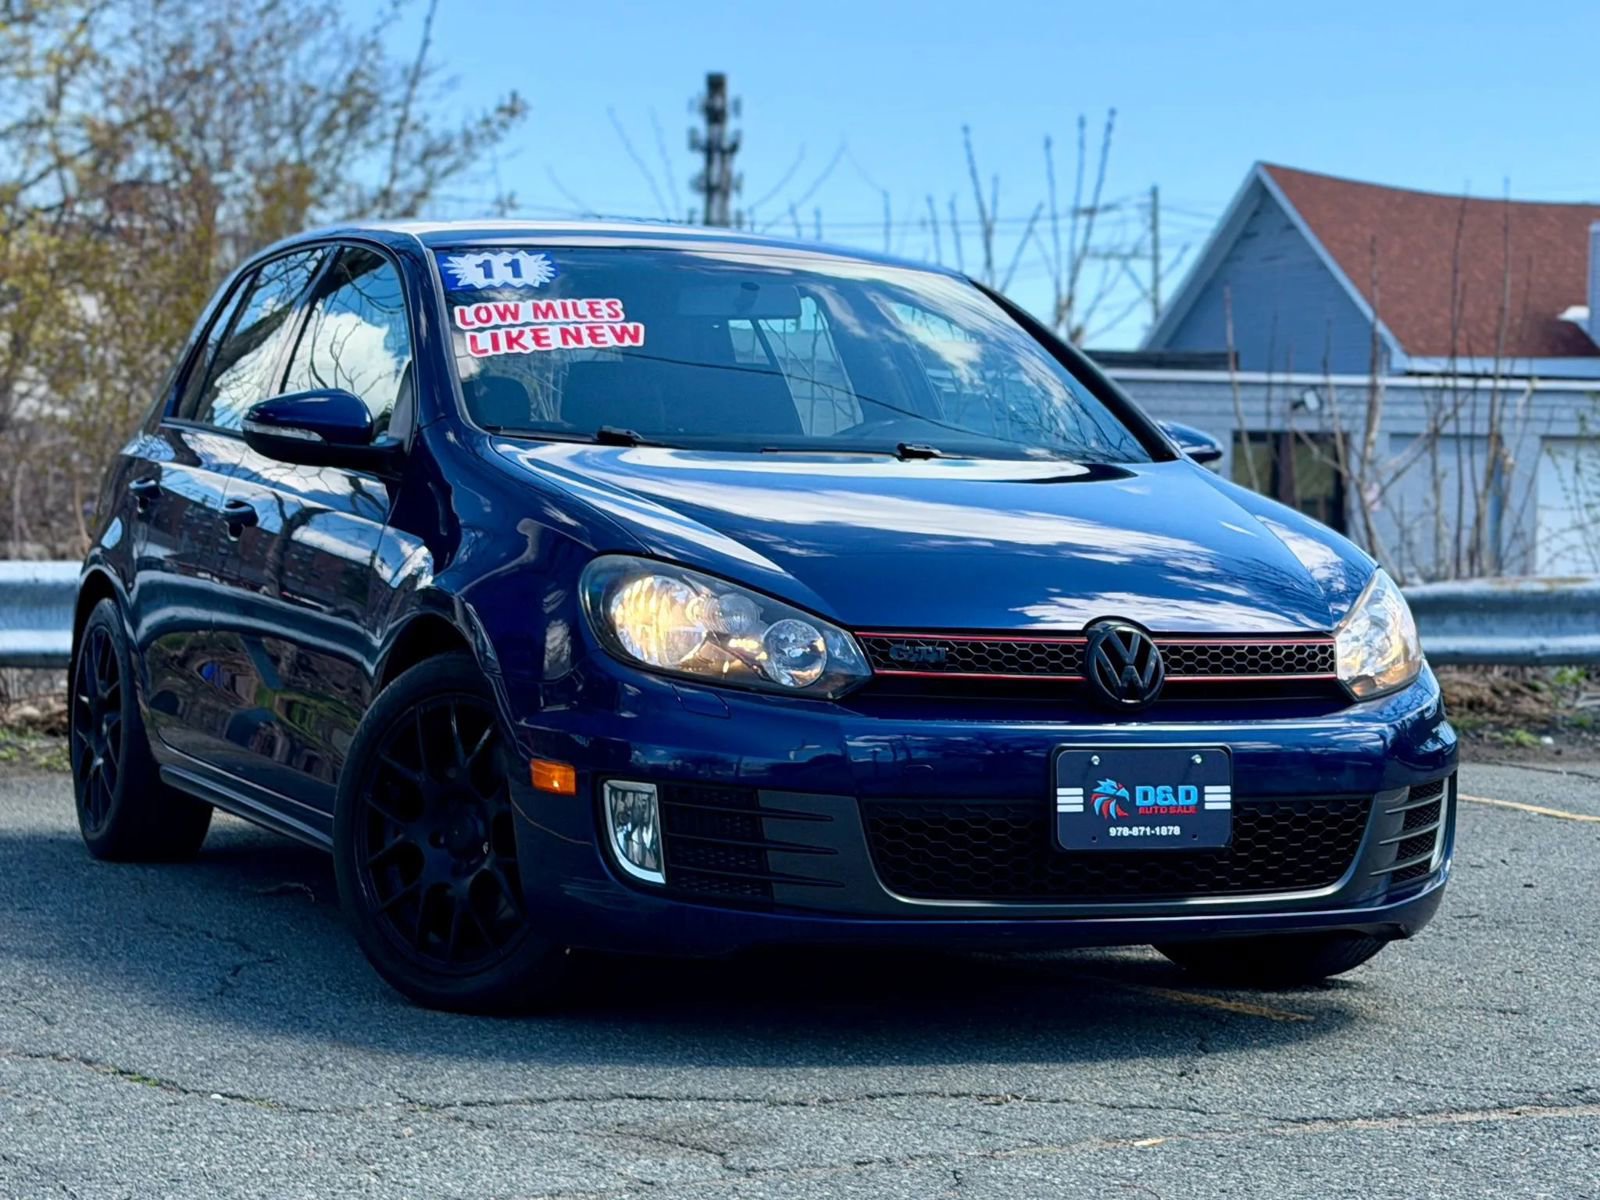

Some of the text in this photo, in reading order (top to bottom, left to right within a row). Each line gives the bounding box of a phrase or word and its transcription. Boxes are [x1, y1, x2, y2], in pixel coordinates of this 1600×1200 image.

[474, 257, 524, 280] 11
[458, 300, 622, 326] LOW MILES
[469, 324, 640, 355] LIKE NEW
[1135, 785, 1198, 806] D&D
[1138, 805, 1198, 815] AUTO SALE
[1109, 826, 1181, 837] 978-871-1878
